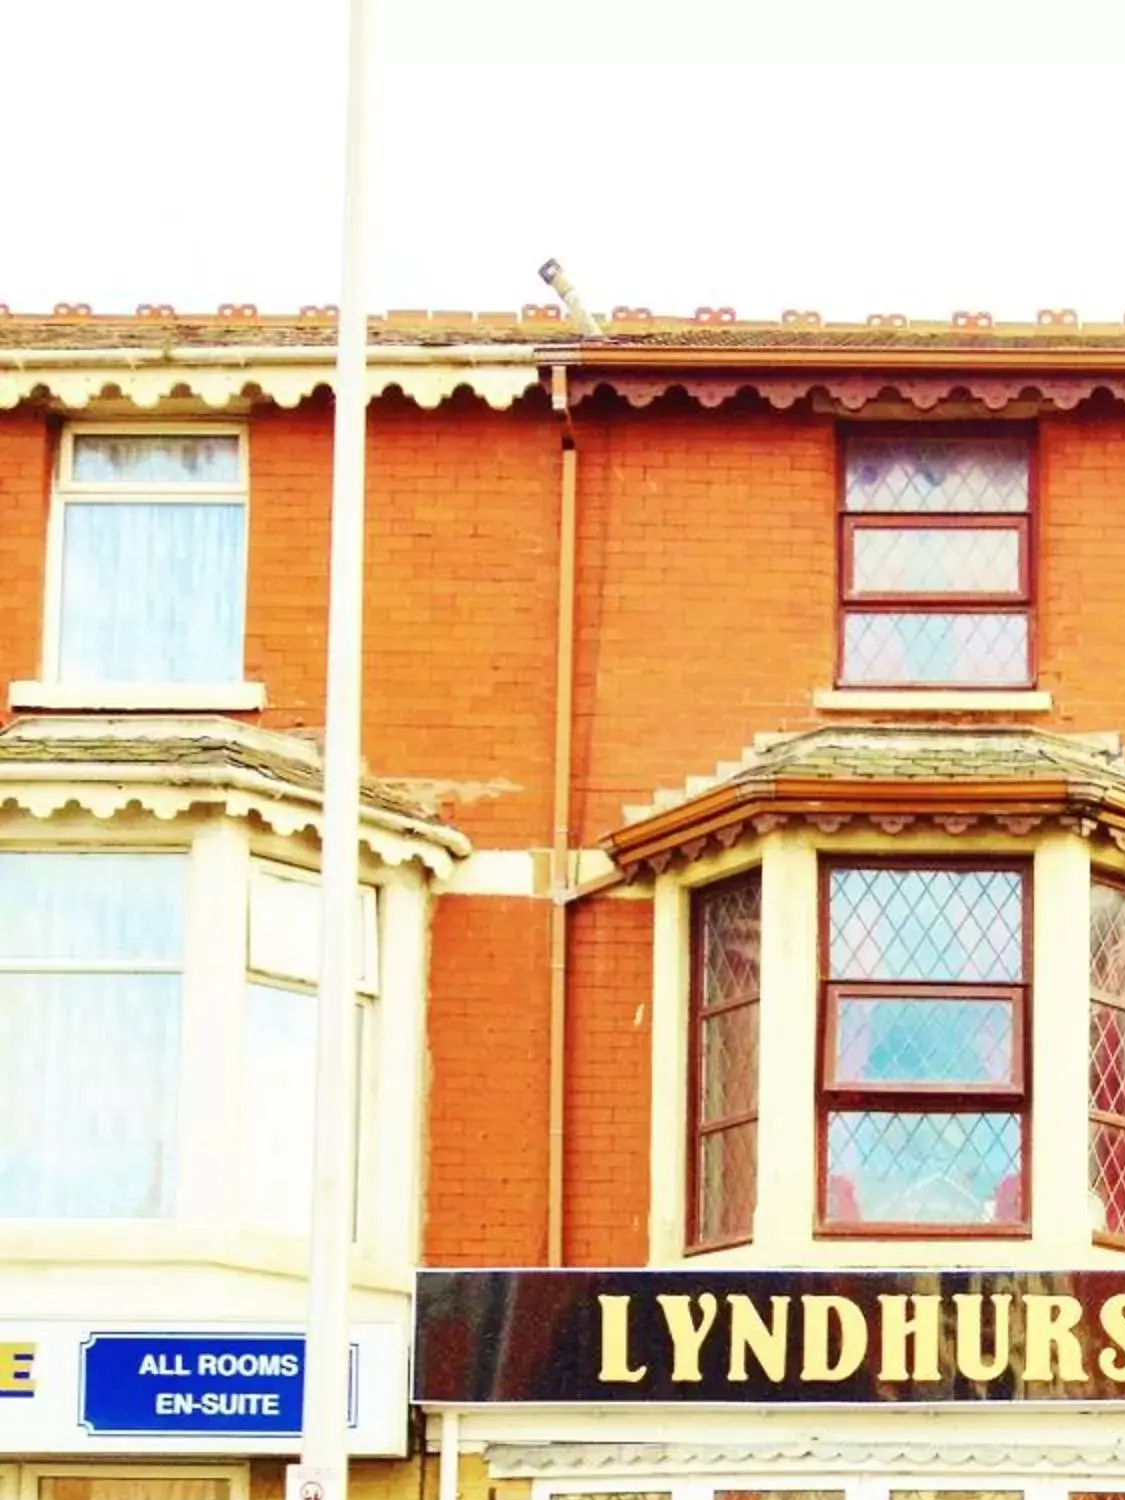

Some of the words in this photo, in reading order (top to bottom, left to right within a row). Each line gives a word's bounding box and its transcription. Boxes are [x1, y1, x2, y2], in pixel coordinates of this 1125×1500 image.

[139, 1354, 191, 1376] ALL
[199, 1354, 300, 1377] ROOMS
[155, 1393, 280, 1416] EN-SUITE
